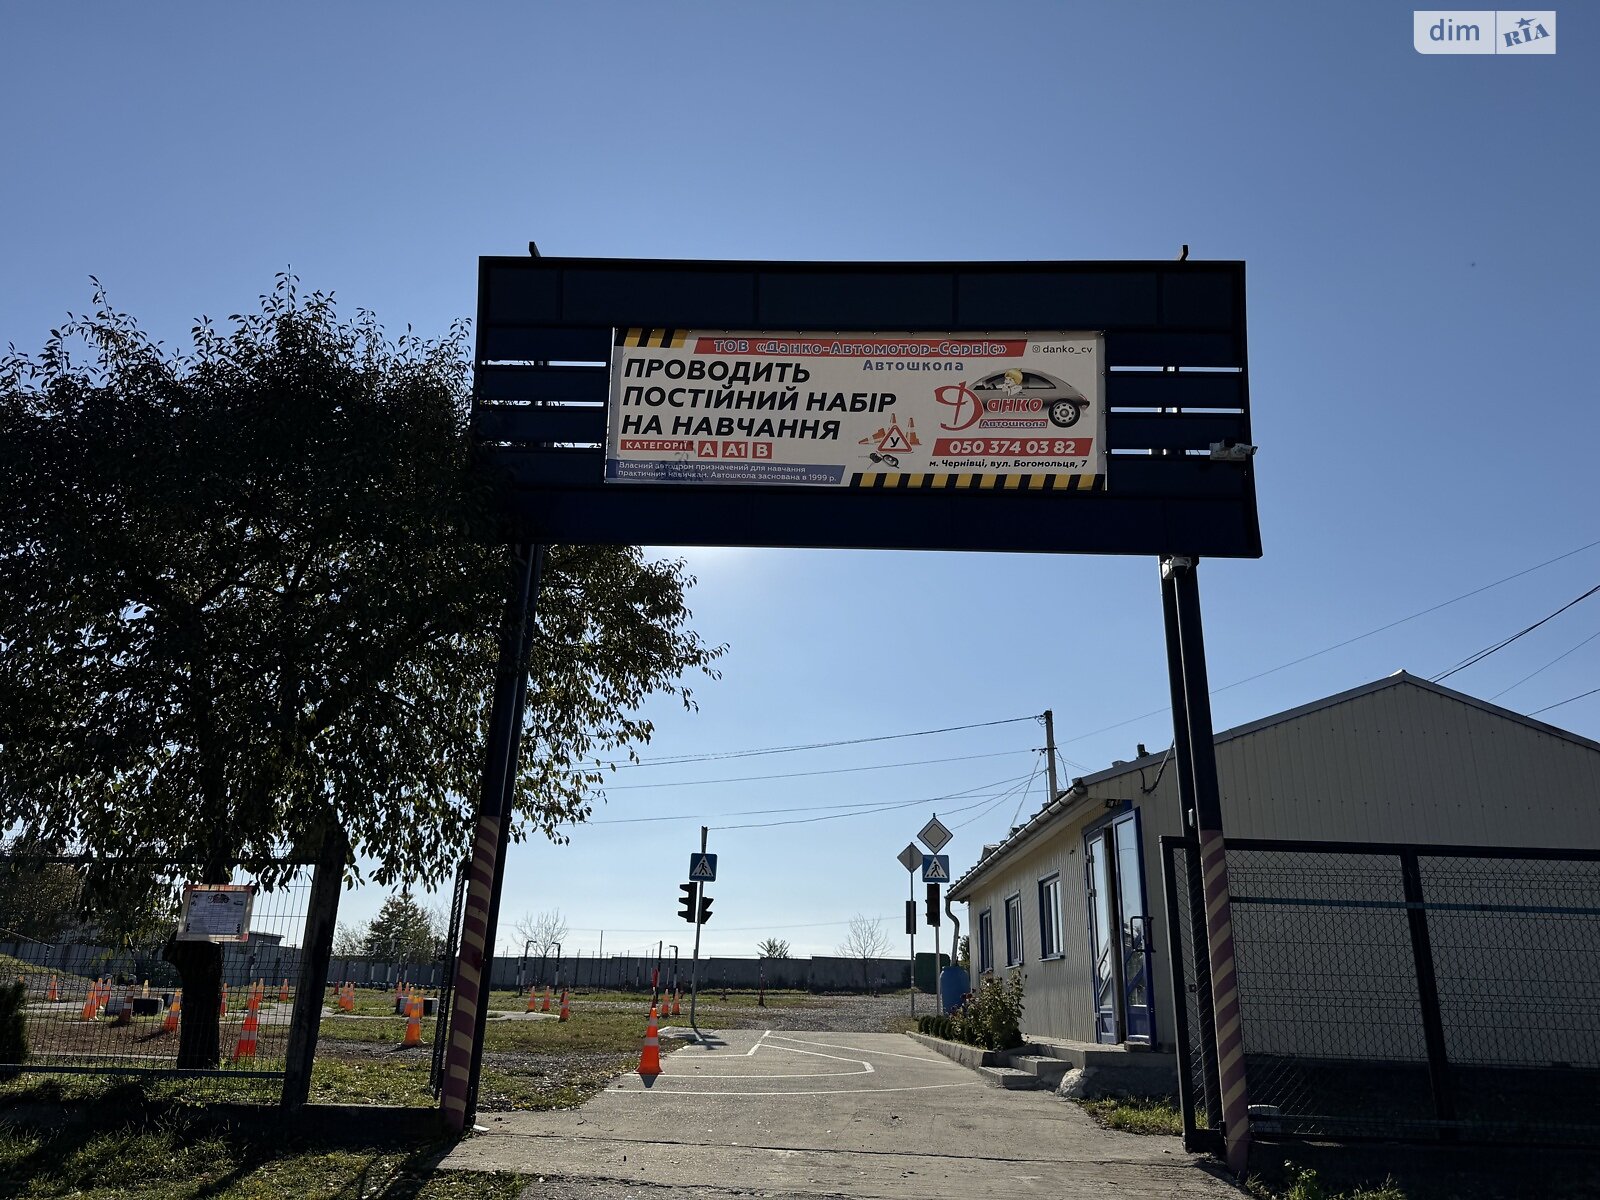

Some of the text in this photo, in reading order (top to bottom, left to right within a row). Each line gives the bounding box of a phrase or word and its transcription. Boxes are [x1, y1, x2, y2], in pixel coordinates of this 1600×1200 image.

[714, 340, 1007, 355] ТОВ «Данко-Автомотор-Сервіс»
[1042, 345, 1093, 355] danko_cv
[863, 359, 964, 371] Автошкола
[624, 358, 810, 385] ПРОВОДИТЬ
[623, 384, 897, 412] ПОСТІЙНИЙ НАБІР
[934, 381, 1043, 431] Данко
[621, 414, 841, 440] НА НАВЧАННЯ
[980, 420, 1047, 428] Автошкола
[626, 440, 688, 450] КАТЕГОРІЇ
[949, 440, 1076, 454] 050 374 03 82
[619, 461, 654, 470] Власний
[695, 463, 749, 472] призначений
[942, 459, 988, 468] Чернівці,
[990, 461, 1011, 469] вул.
[1014, 459, 1078, 469] Богомольця,
[1081, 459, 1088, 468] 7
[618, 470, 666, 478] практичним
[809, 473, 828, 481] 1999
